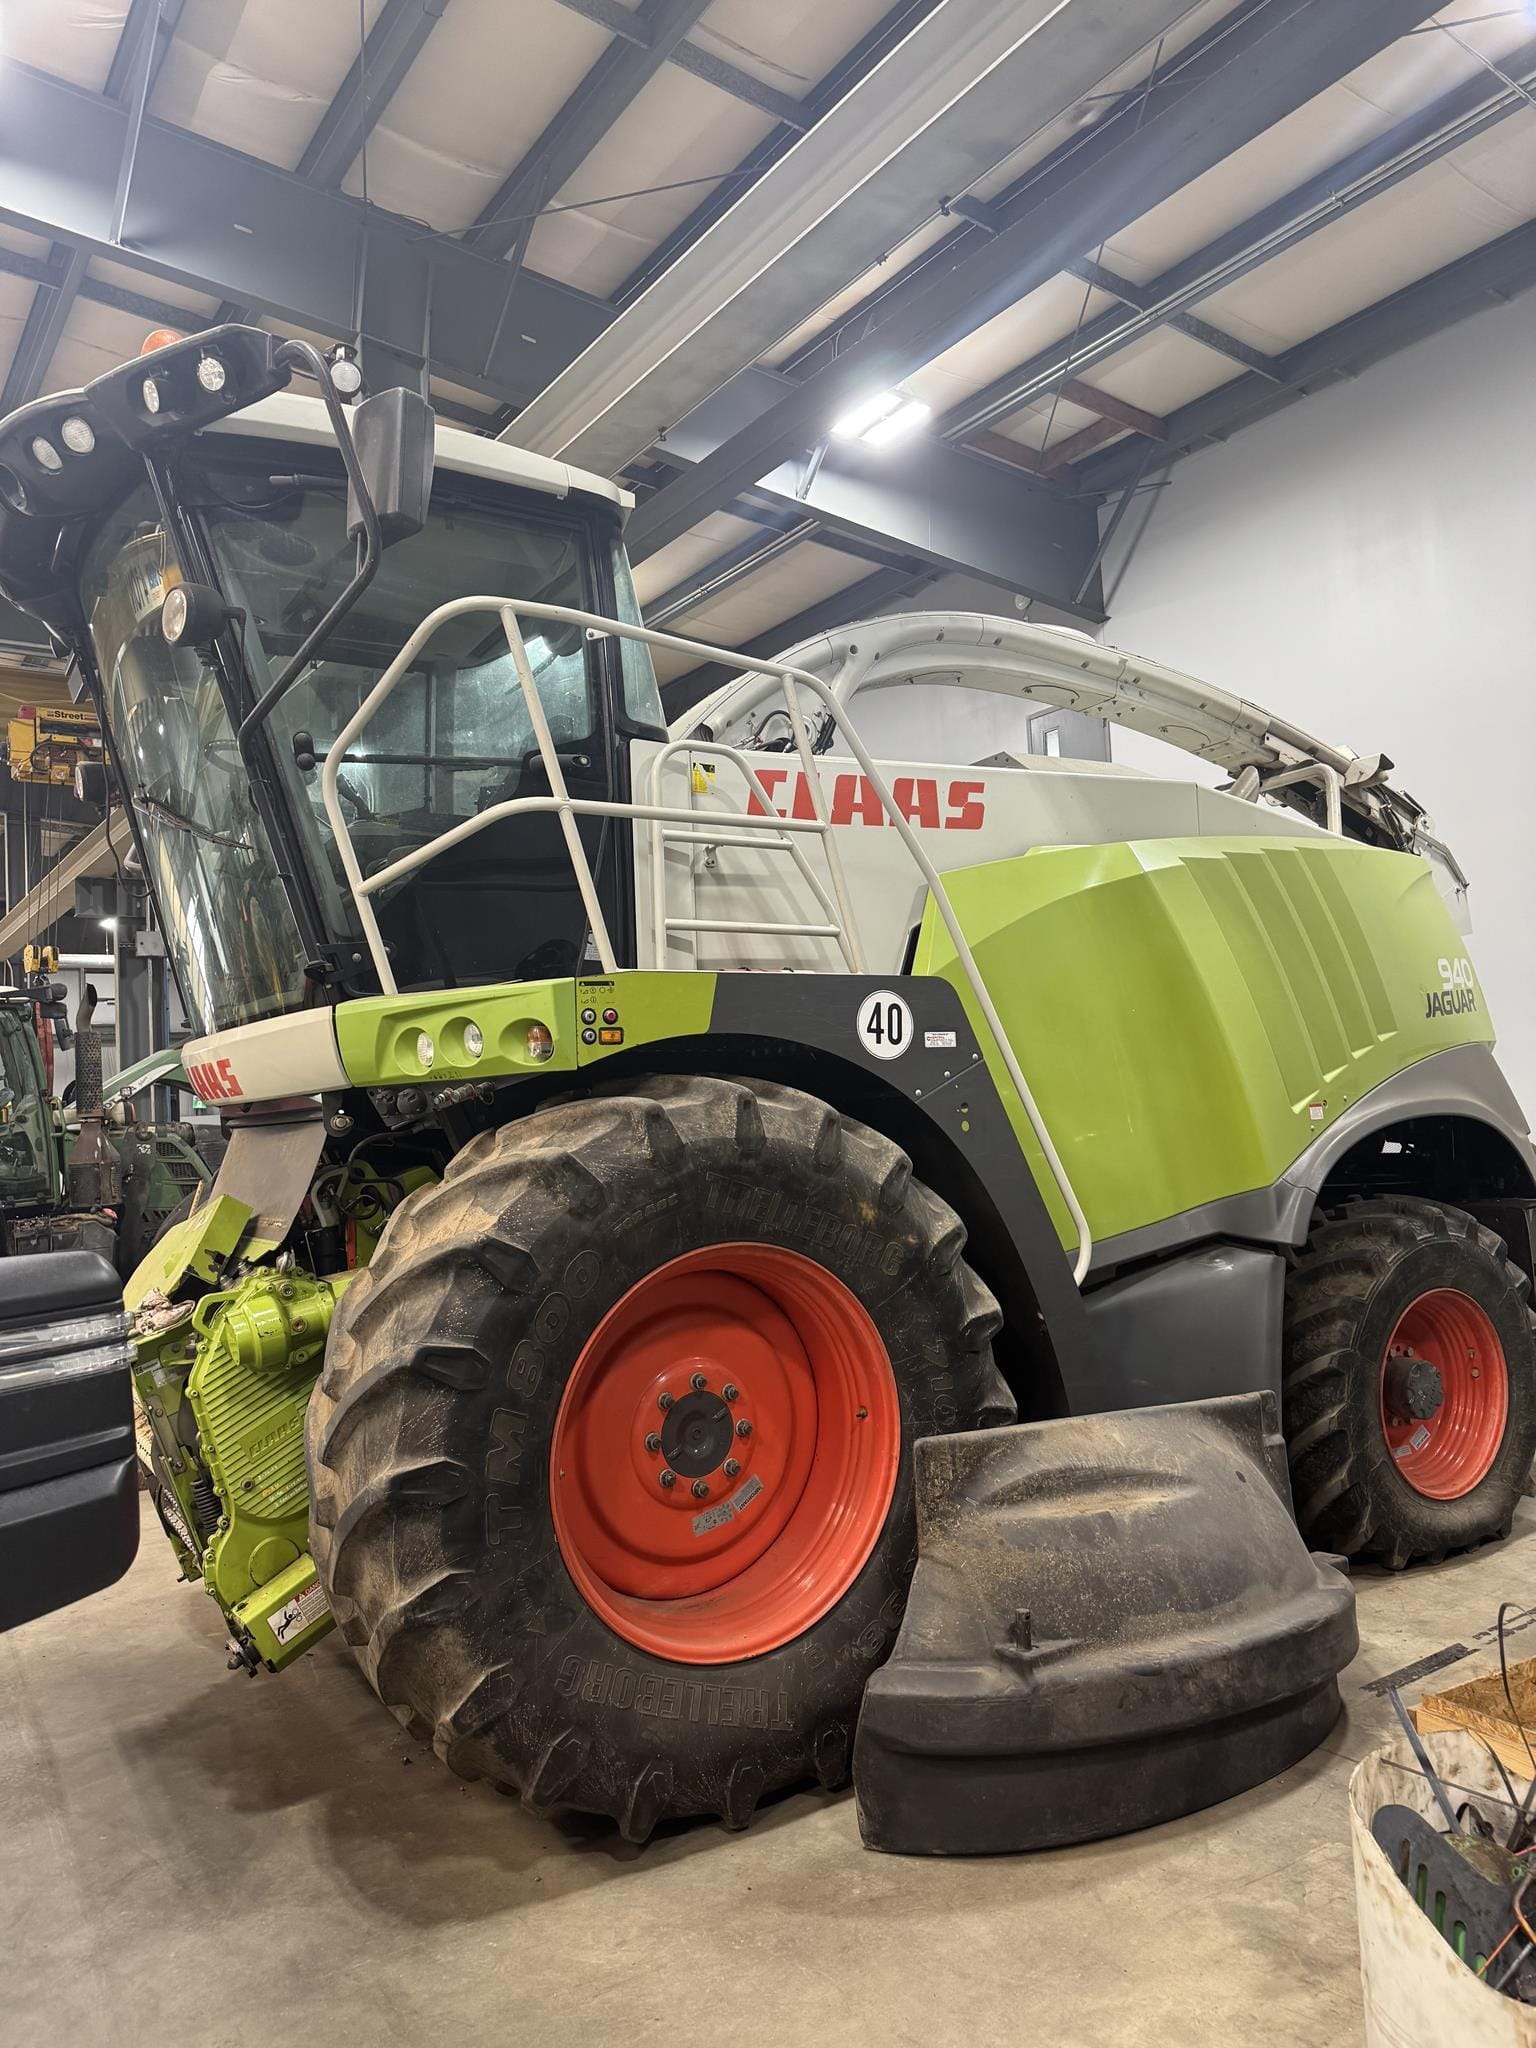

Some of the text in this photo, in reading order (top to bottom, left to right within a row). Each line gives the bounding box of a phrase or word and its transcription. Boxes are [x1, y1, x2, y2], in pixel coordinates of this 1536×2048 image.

[54, 711, 84, 720] Street
[1437, 958, 1474, 990] 940
[1425, 988, 1477, 1019] JAGUAR
[867, 1002, 903, 1045] 40
[186, 1058, 244, 1101] AAS
[554, 1655, 794, 1732] TRELLEBORG
